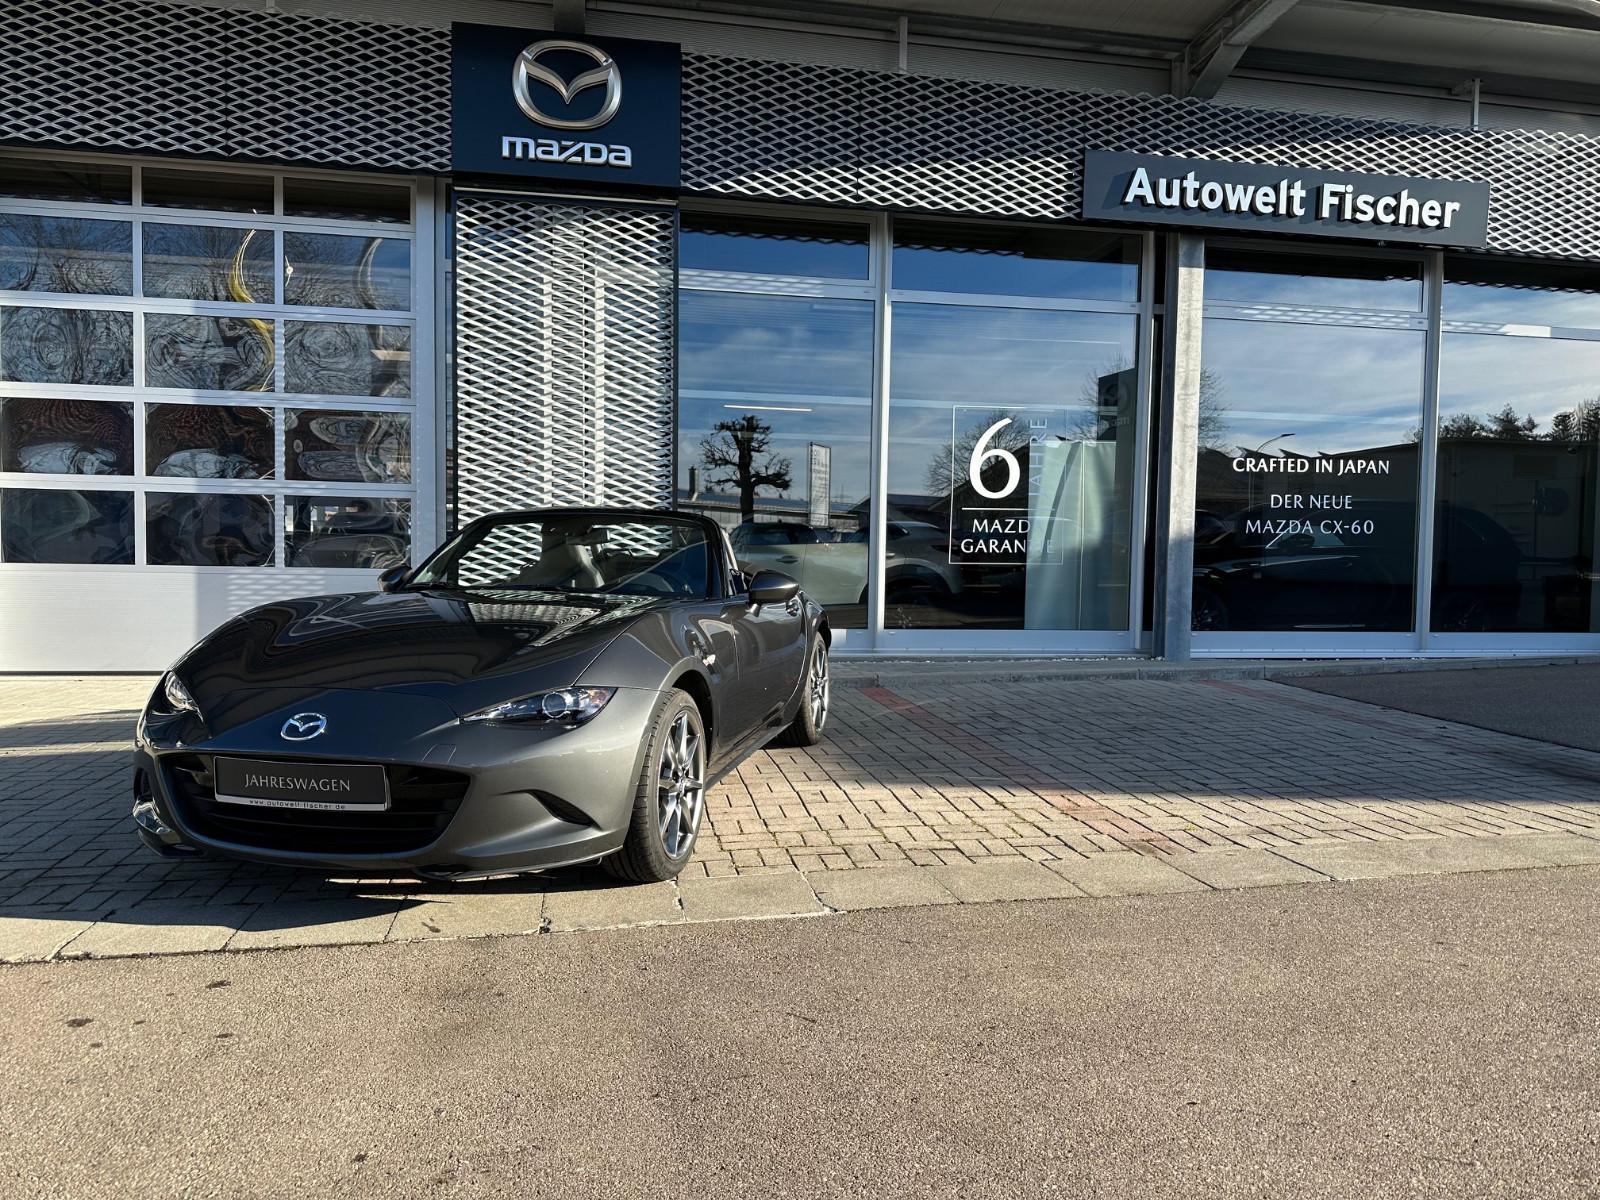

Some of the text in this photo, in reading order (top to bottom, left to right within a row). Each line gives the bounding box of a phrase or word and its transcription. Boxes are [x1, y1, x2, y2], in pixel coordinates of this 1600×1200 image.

[1122, 167, 1461, 229] Autowelt Fischer
[969, 417, 1021, 499] 6
[1232, 457, 1390, 477] CRAFTED IN JAPAN
[1270, 494, 1353, 510] DER NEUE
[972, 518, 1034, 534] MAZD
[1245, 519, 1375, 535] MAZDA CX-60
[244, 773, 351, 792] JAHRESWAGEN
